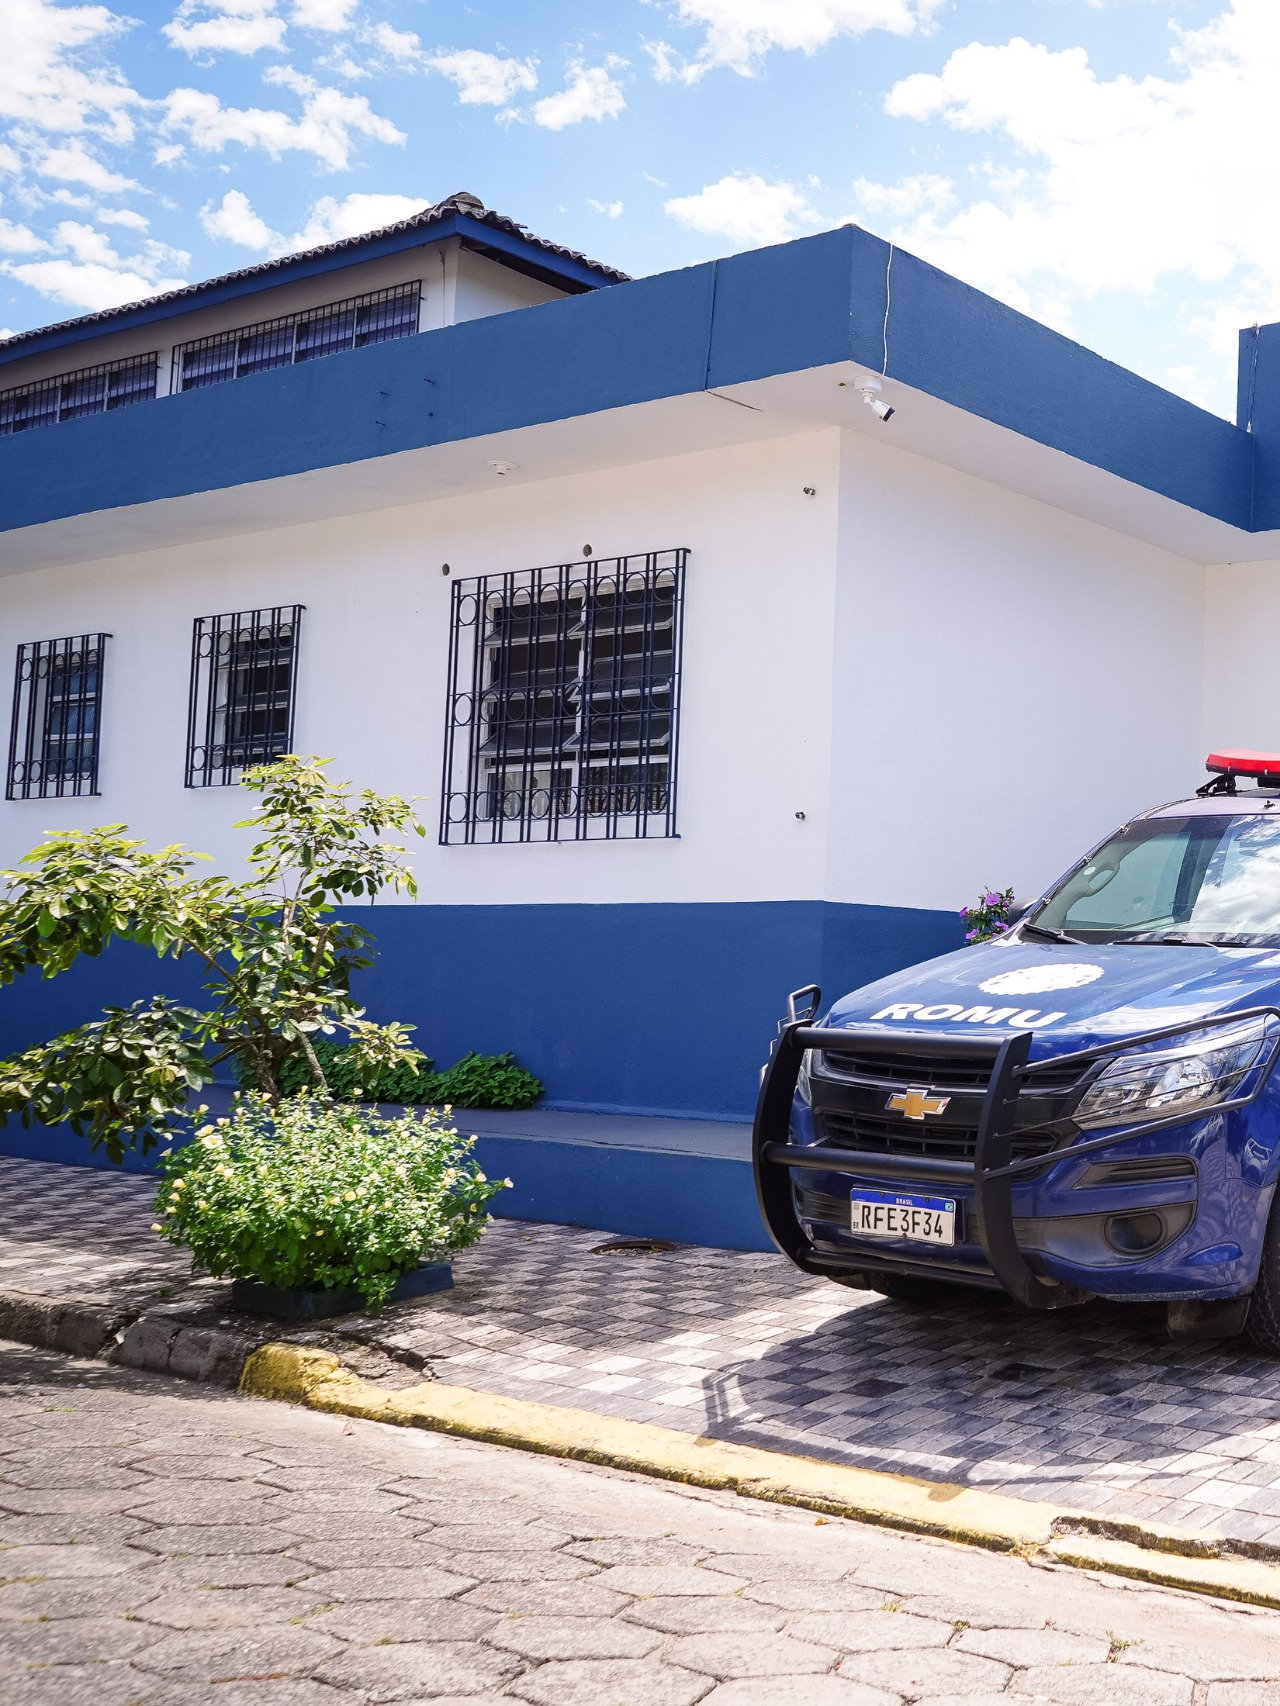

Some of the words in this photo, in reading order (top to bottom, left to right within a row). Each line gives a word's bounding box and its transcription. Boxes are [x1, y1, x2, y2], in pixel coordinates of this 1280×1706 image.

[869, 1003, 1068, 1028] ROMU
[896, 1198, 914, 1206] BRASIL
[861, 1205, 943, 1238] RFE3F34
